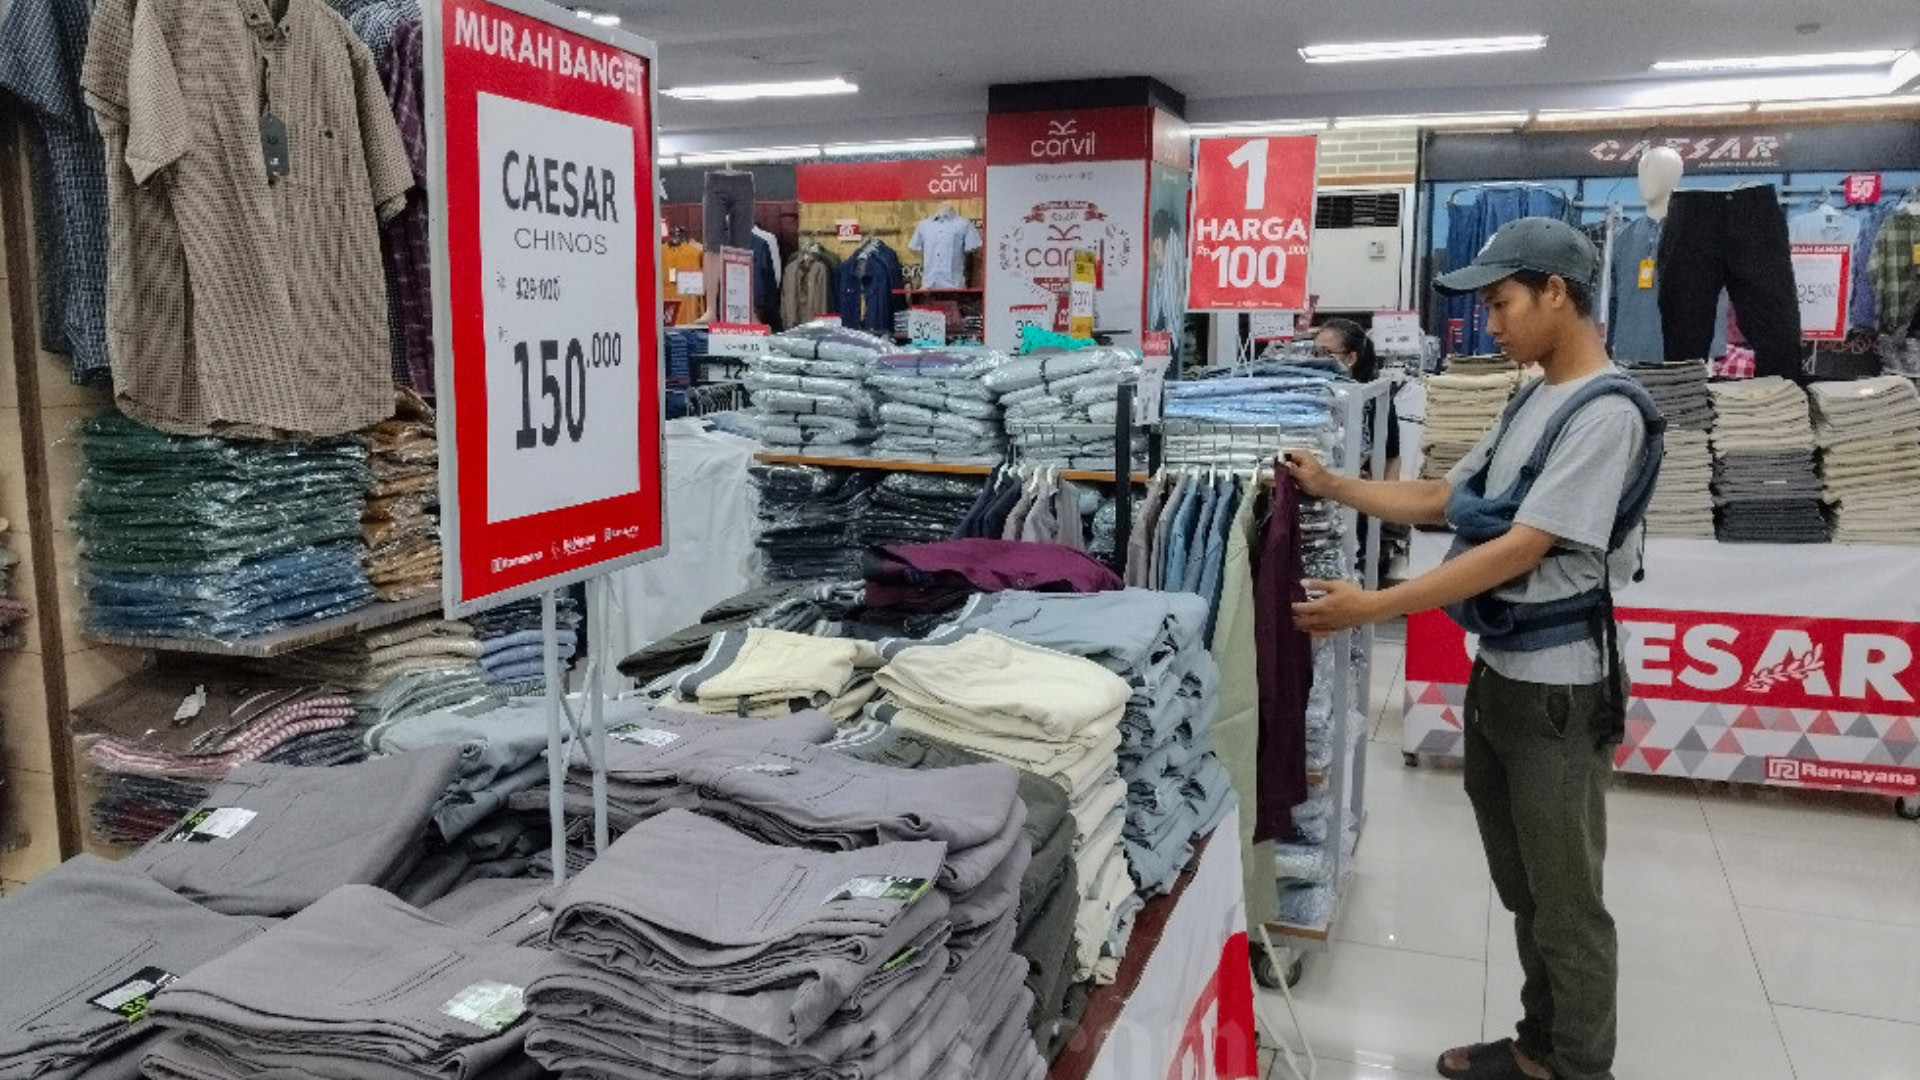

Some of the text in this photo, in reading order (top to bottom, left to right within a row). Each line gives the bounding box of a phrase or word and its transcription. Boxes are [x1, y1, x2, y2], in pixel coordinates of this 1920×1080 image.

[455, 7, 644, 96] MURAH BANGET
[1031, 131, 1096, 157] carvil
[502, 150, 619, 223] CAESAR
[927, 173, 978, 194] carvil
[1227, 138, 1269, 210] 1
[514, 228, 608, 255] CHINOS
[1197, 217, 1308, 241] HARGA
[1801, 762, 1918, 786] Ramayana
